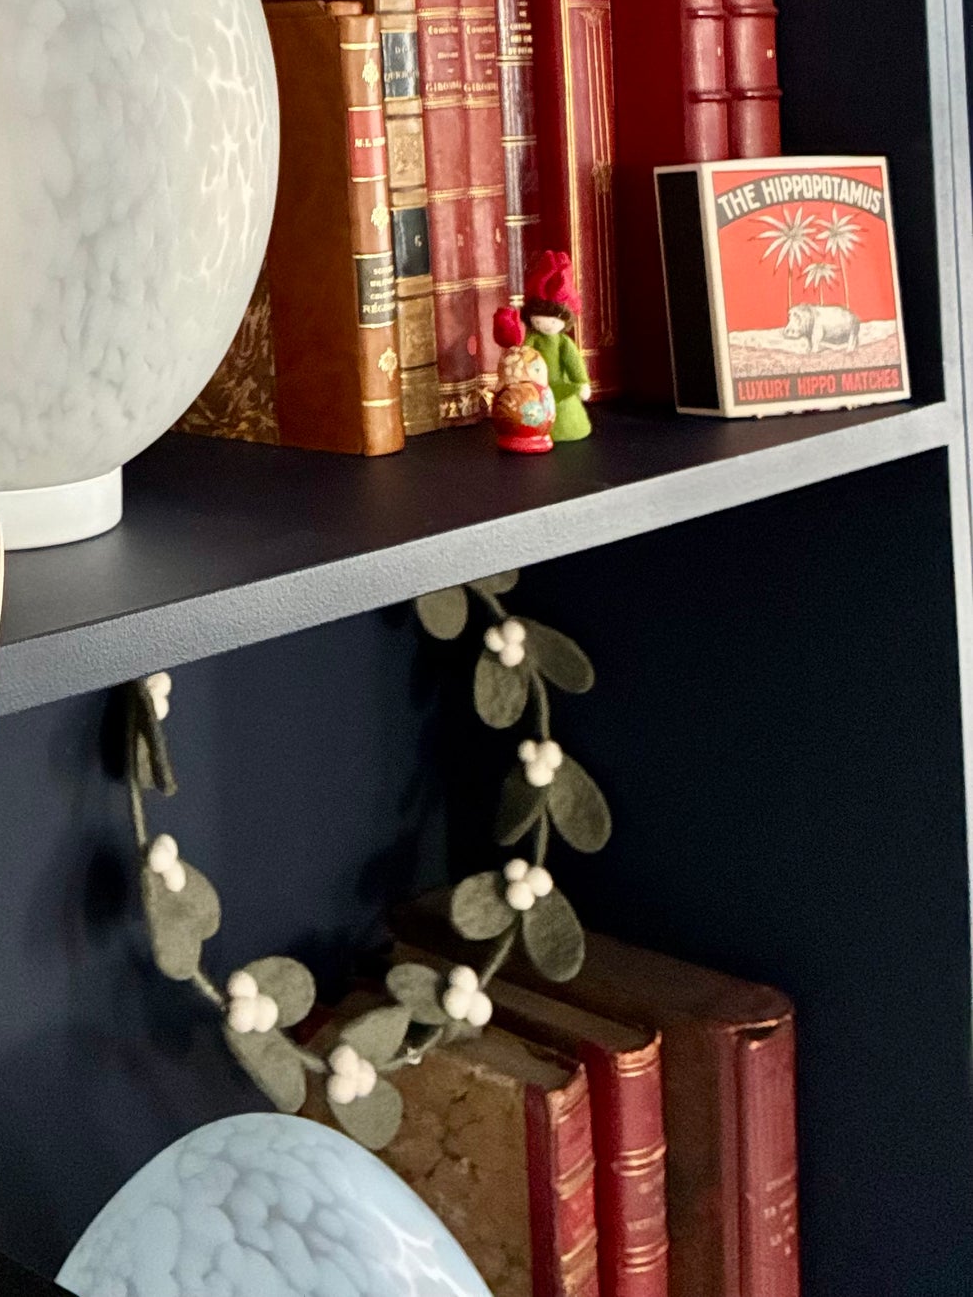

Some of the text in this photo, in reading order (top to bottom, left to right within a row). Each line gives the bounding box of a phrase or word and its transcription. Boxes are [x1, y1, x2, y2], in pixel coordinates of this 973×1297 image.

[717, 174, 883, 220] THE HIPPOPOTAMUS
[738, 368, 900, 401] LUXURY HIPPO MATCHES
